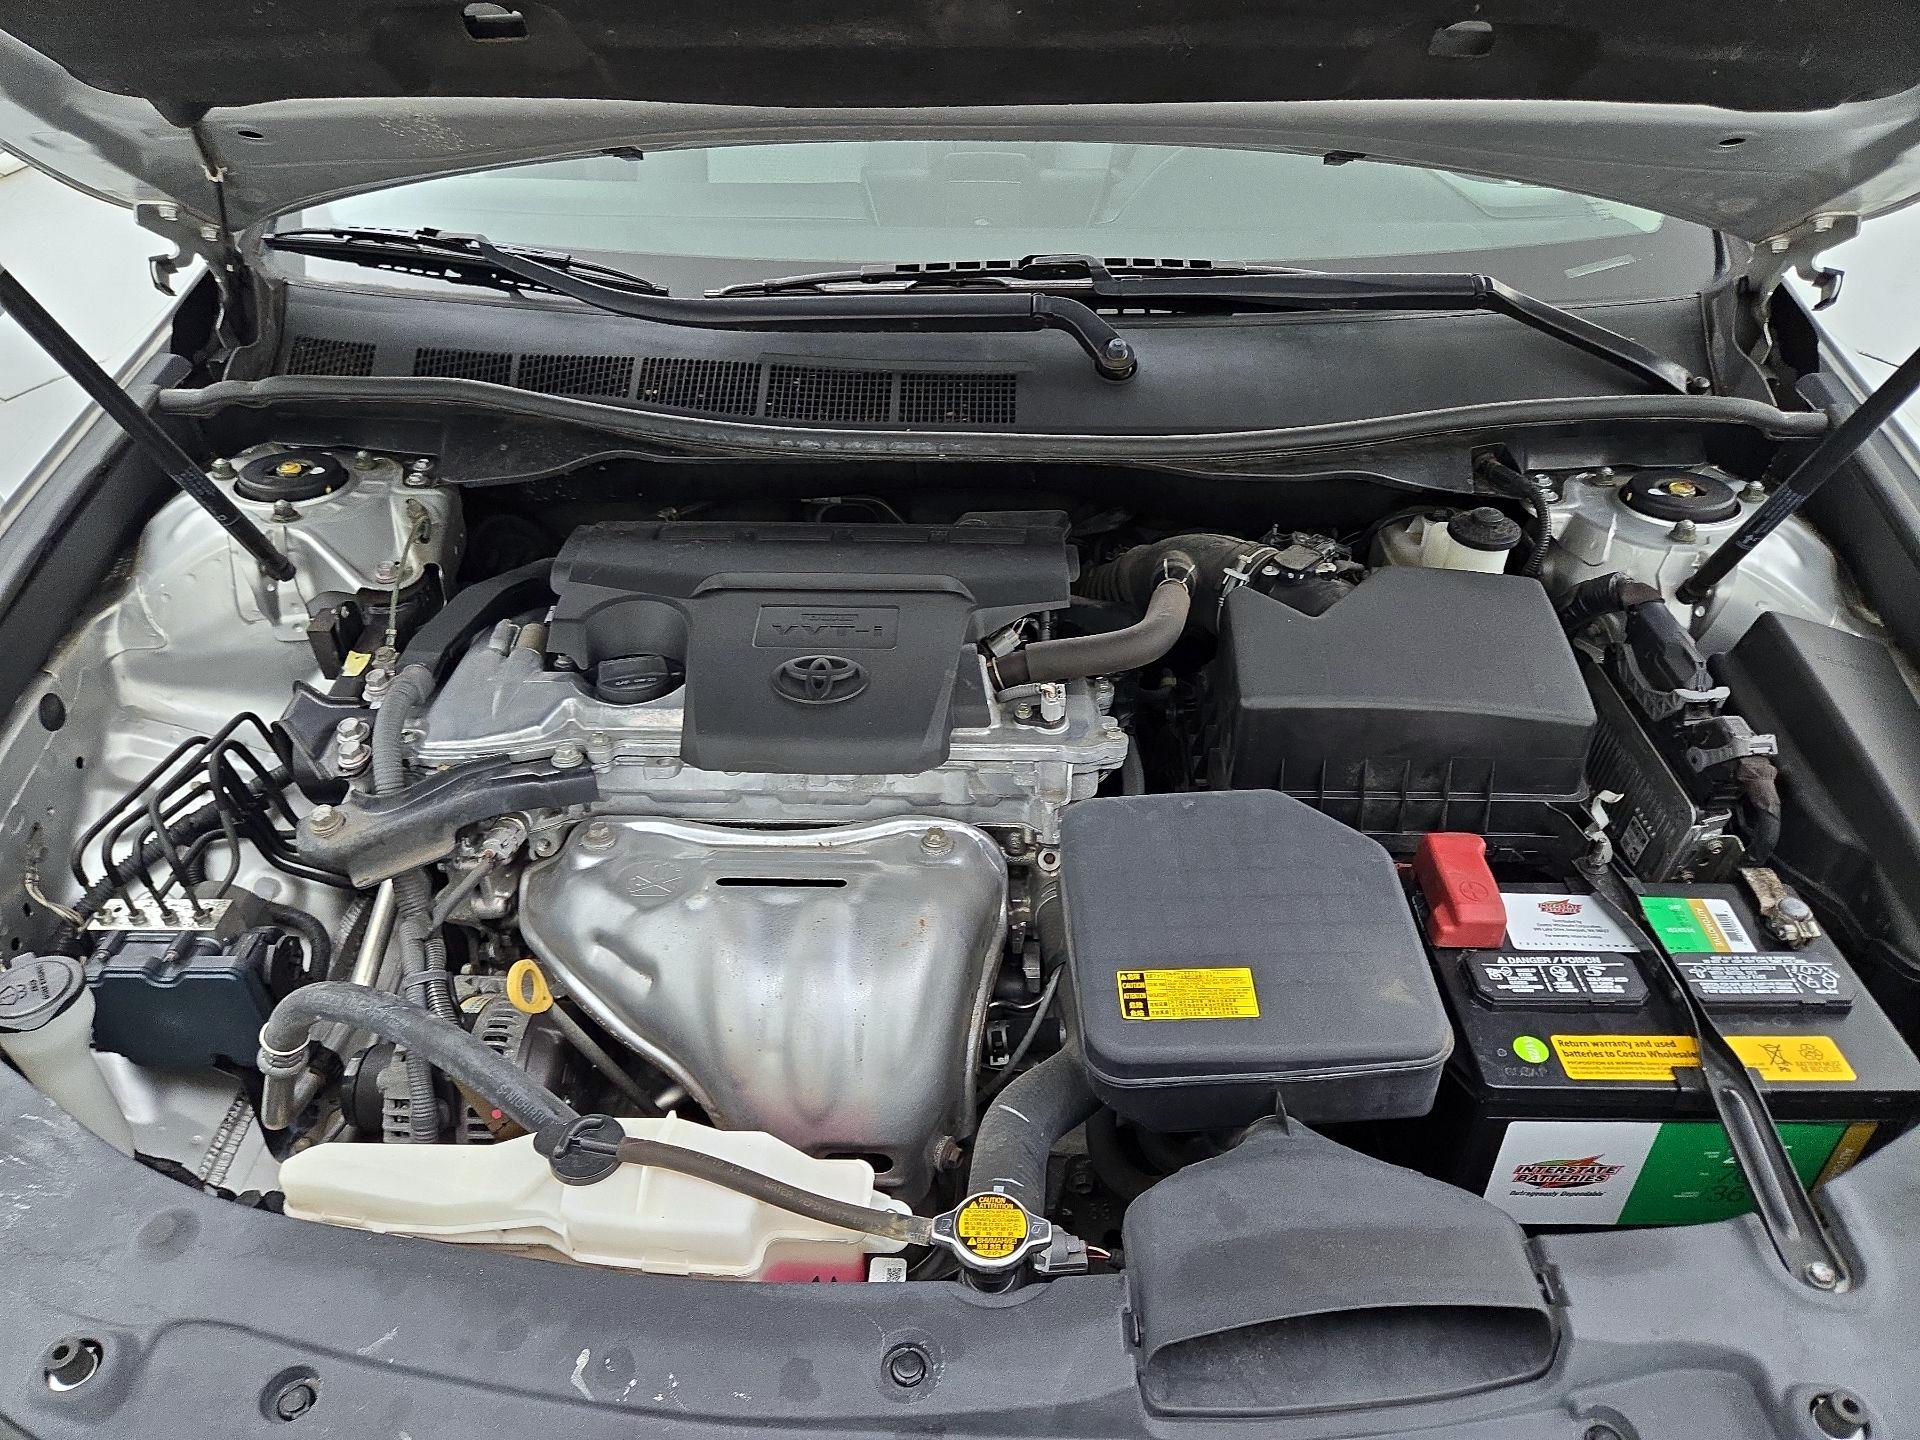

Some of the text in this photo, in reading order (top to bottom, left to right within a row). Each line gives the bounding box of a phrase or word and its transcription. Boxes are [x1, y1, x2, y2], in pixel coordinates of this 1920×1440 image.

[1695, 907, 1724, 948] AUTOMOTIVE
[1507, 956, 1551, 964] DANGER
[1561, 956, 1602, 964] POISON
[1557, 1039, 1677, 1050] Return warranty and used
[1562, 1049, 1605, 1058] batteries
[1605, 1050, 1616, 1058] to
[1617, 1050, 1647, 1058] Costco
[1515, 1165, 1620, 1174] INTERSTATE
[1515, 1174, 1608, 1182] BATTERIES
[1509, 1190, 1558, 1198] Outrageously
